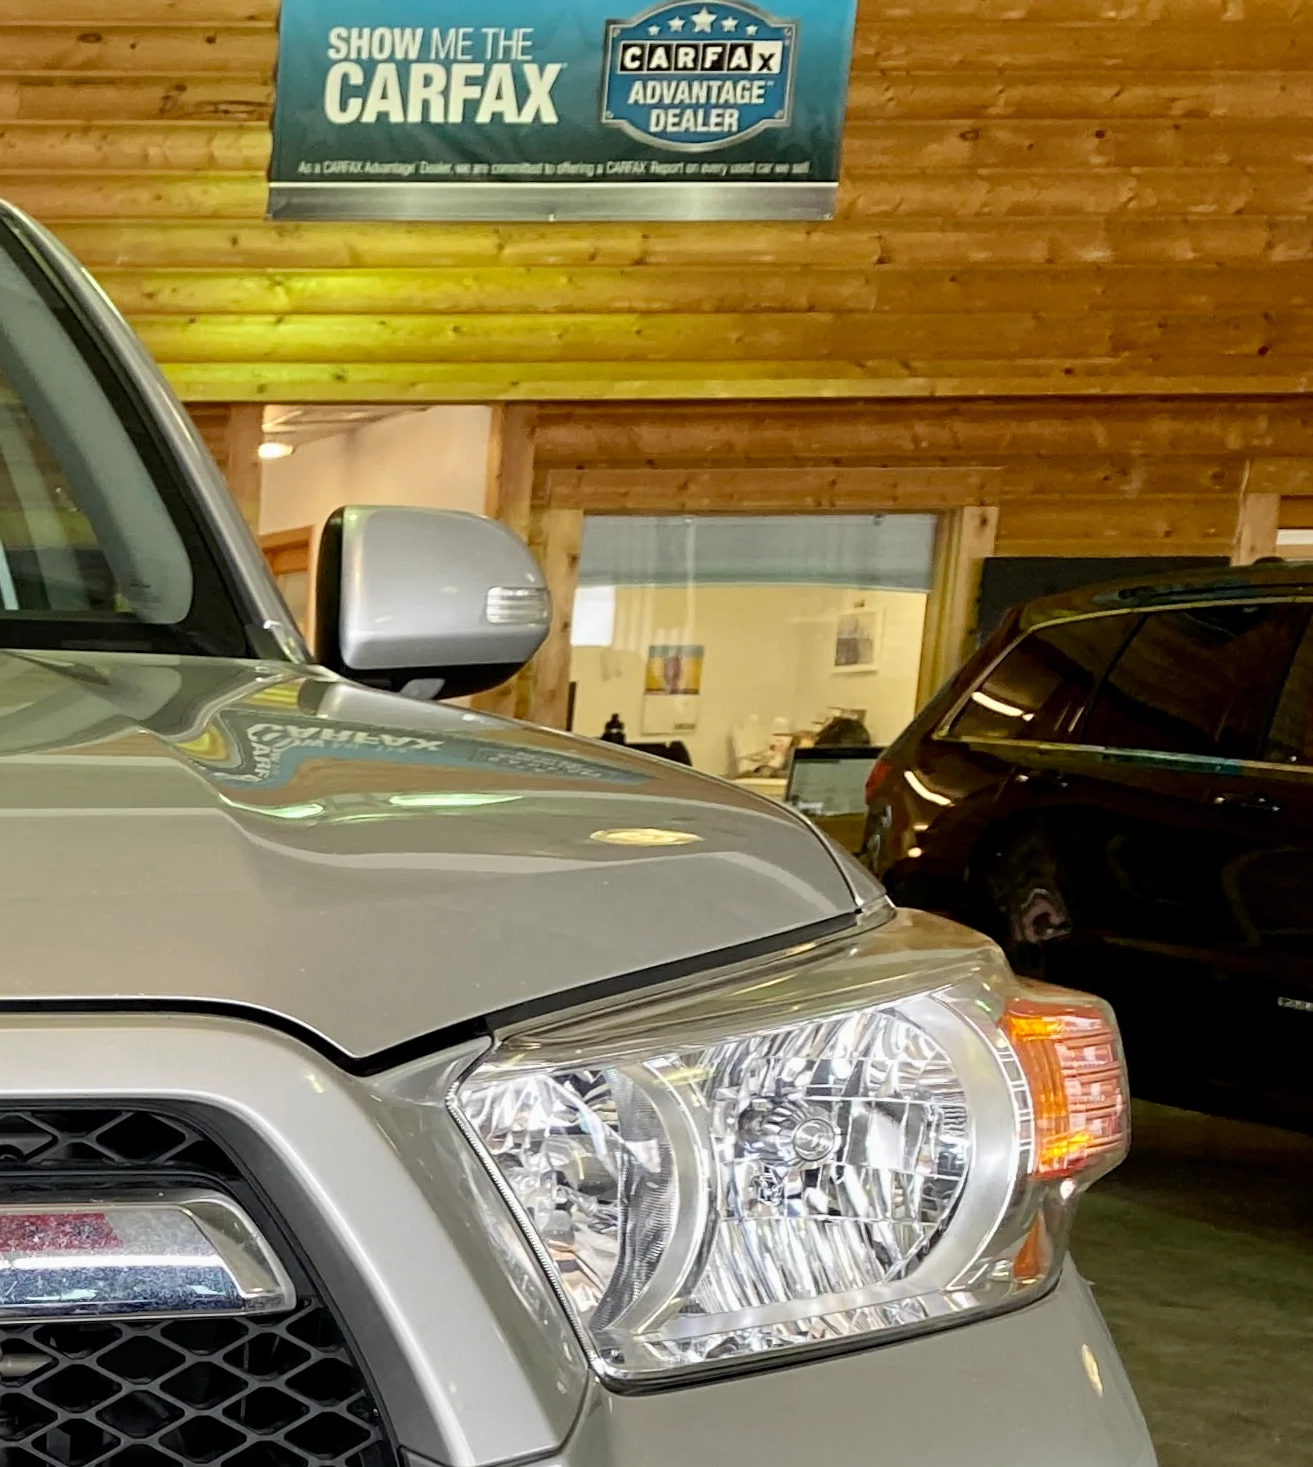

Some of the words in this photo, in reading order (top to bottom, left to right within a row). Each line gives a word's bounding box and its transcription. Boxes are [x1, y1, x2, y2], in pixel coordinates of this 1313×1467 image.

[327, 27, 424, 60] SHOW
[429, 28, 474, 60] ME
[481, 28, 534, 60] THE
[624, 46, 776, 72] CARFAX
[324, 61, 564, 124] CARFAX
[627, 80, 766, 104] ADVANTAGE
[649, 108, 740, 133] DEALER
